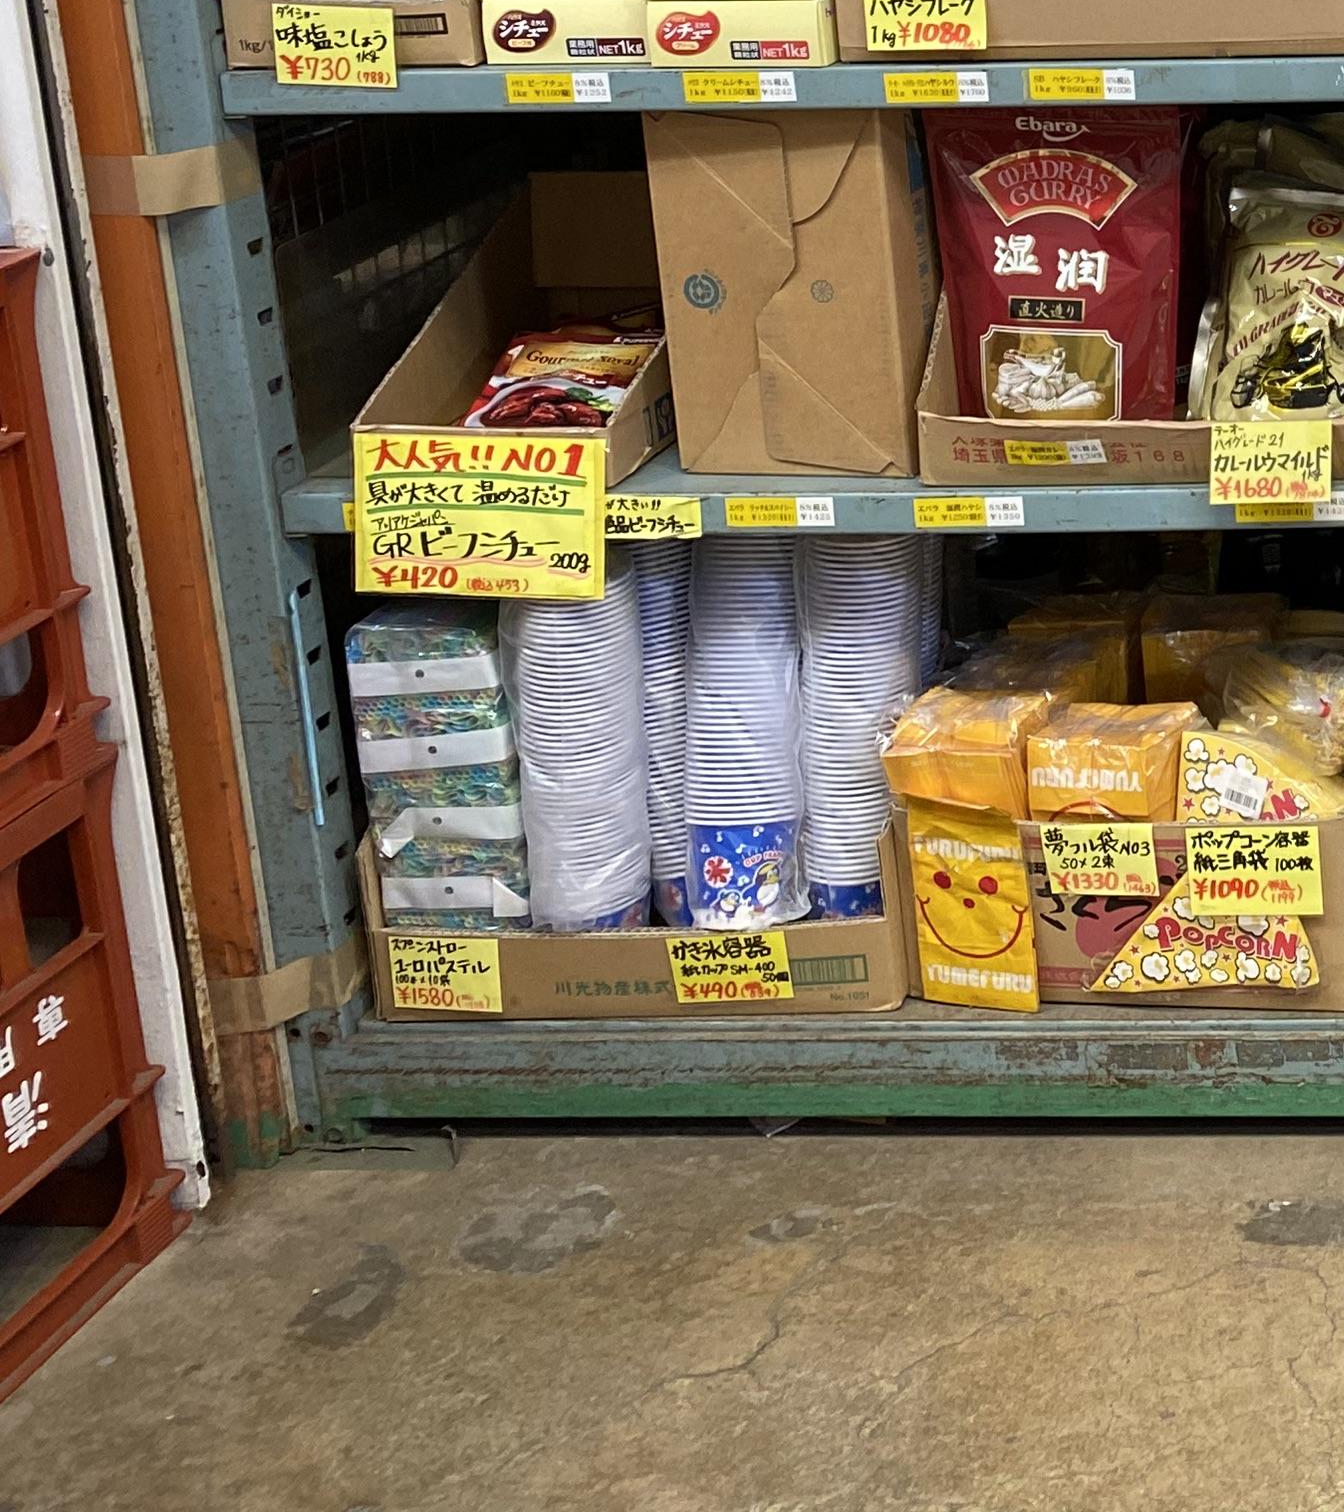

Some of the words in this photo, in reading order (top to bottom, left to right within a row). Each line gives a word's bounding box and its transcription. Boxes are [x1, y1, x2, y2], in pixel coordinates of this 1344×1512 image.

[275, 24, 389, 55] 味塩こしょう
[283, 54, 351, 82] ¥730
[1015, 115, 1080, 133] Ebara
[1015, 301, 1078, 319] 直火造り
[366, 439, 495, 473] 大人気!!
[502, 442, 586, 479] NO1
[365, 481, 466, 506] 具が大きくて
[473, 480, 570, 508] 温めるだけ
[549, 551, 592, 574] 200g
[372, 564, 458, 590] ¥420
[1053, 872, 1119, 892] ¥1330
[1193, 879, 1260, 901] ¥1090
[397, 986, 455, 1007] ¥1580
[681, 980, 738, 1002] ¥490
